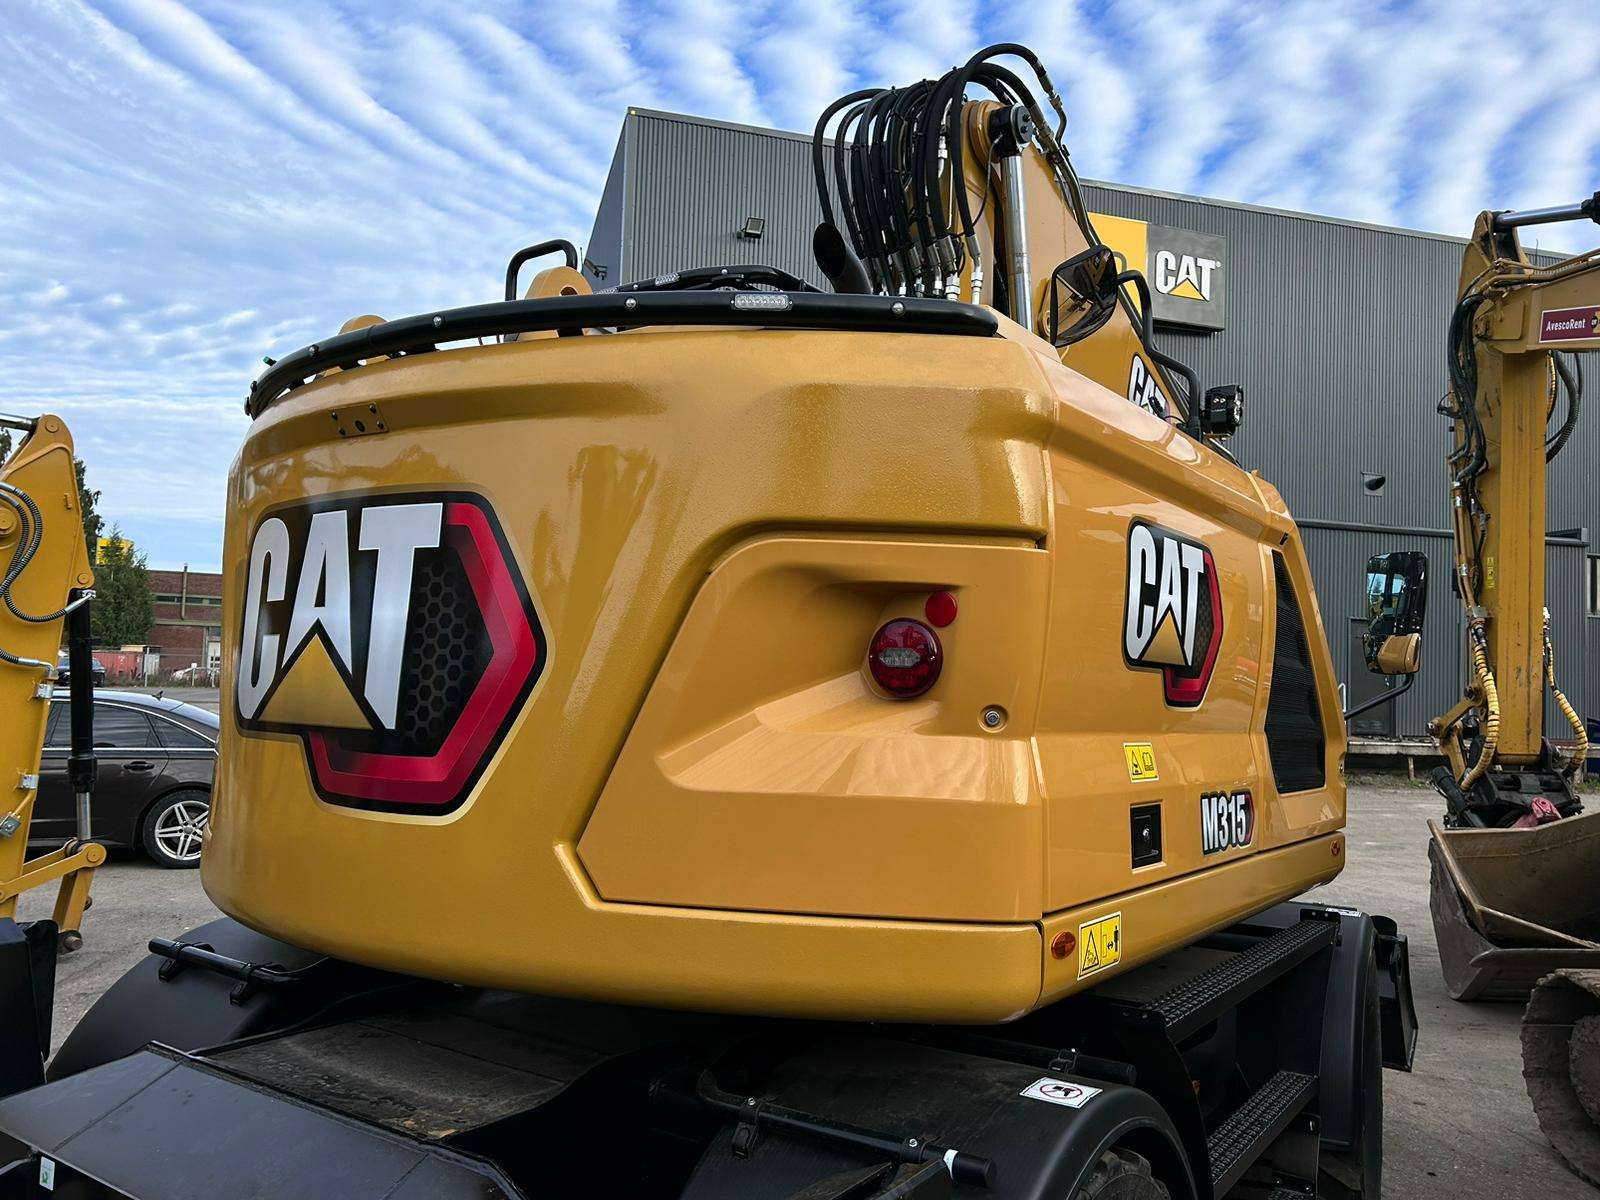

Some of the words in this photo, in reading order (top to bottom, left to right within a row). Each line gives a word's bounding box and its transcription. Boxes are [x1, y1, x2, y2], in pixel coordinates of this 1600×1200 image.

[1546, 318, 1585, 331] AvescoRent
[238, 502, 443, 730] CAT
[1126, 525, 1204, 666] CAT
[1202, 794, 1246, 850] M315
